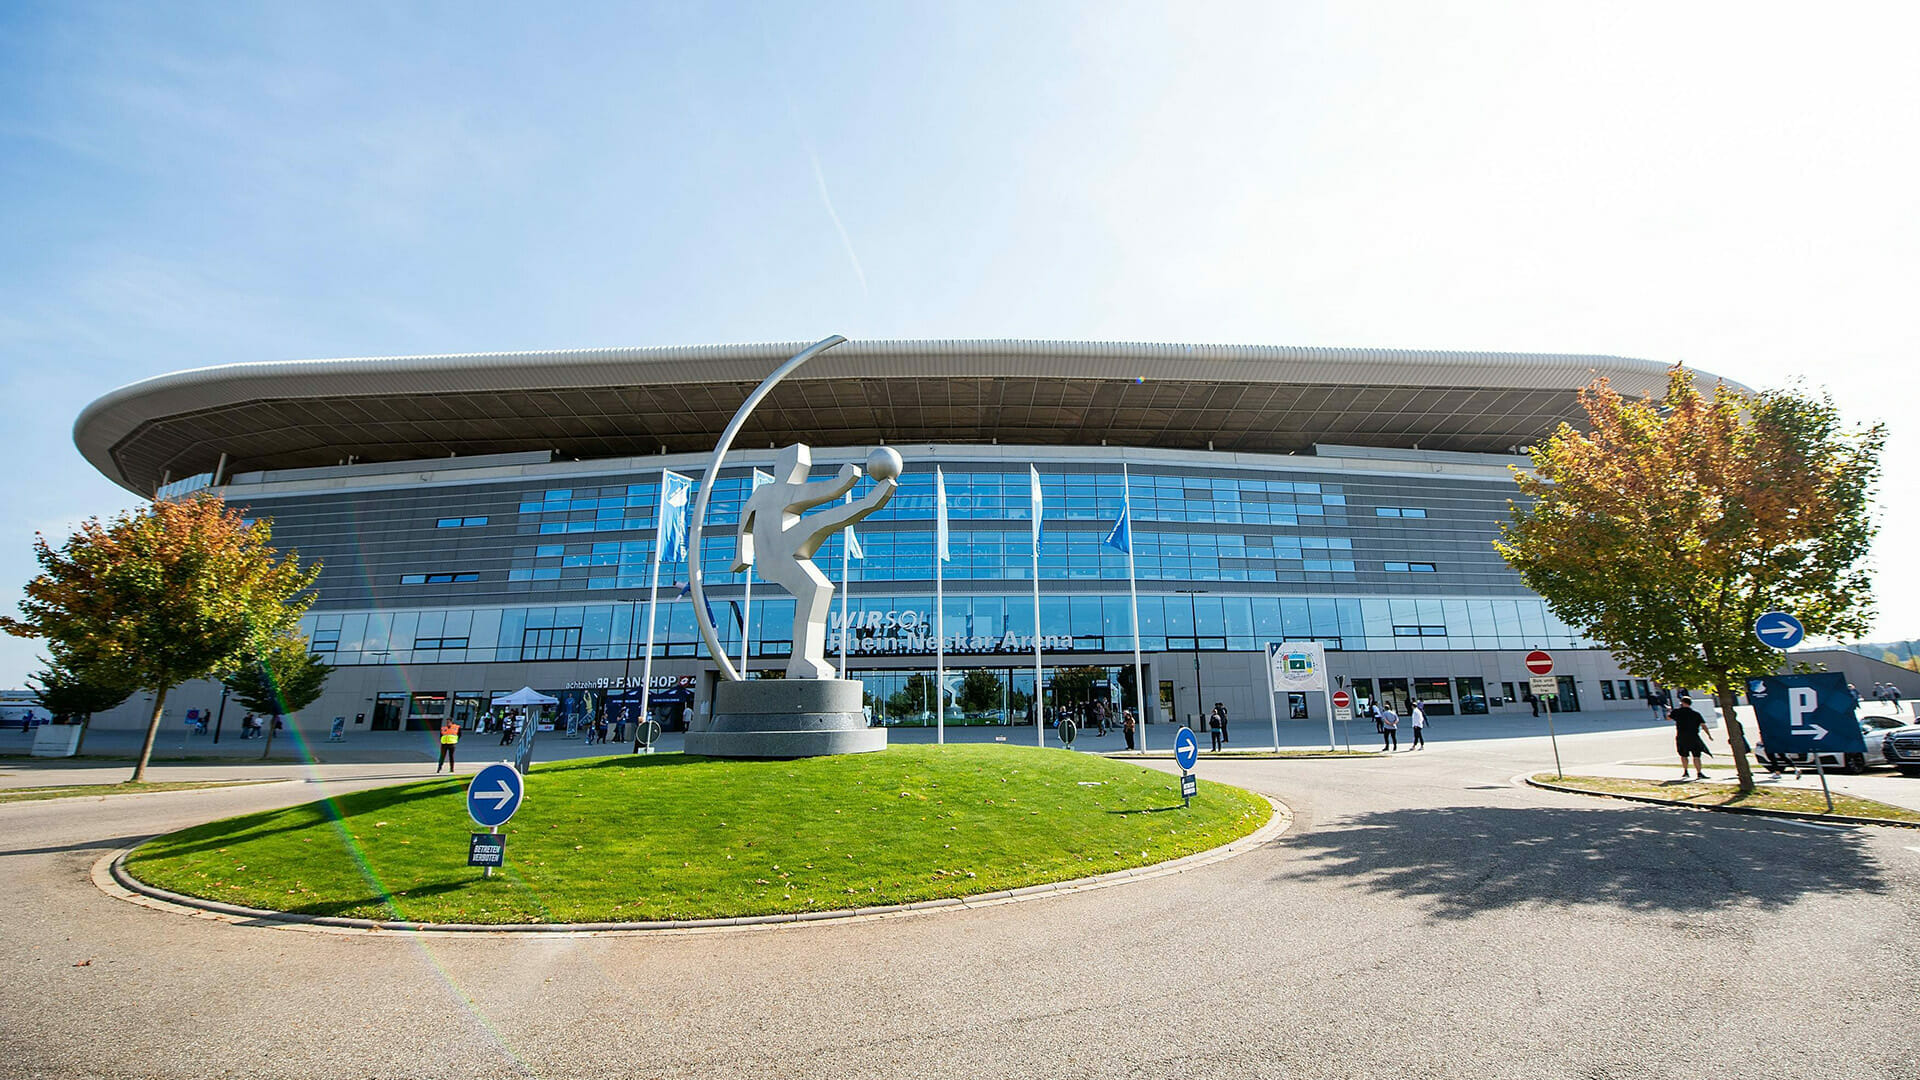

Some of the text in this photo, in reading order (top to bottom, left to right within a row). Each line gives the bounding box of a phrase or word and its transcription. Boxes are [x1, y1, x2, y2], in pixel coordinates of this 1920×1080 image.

[830, 610, 928, 631] WIRSOL
[829, 631, 1073, 650] Rhein-Neckar-Arena
[1788, 686, 1818, 726] P
[474, 845, 501, 853] BETRETEN
